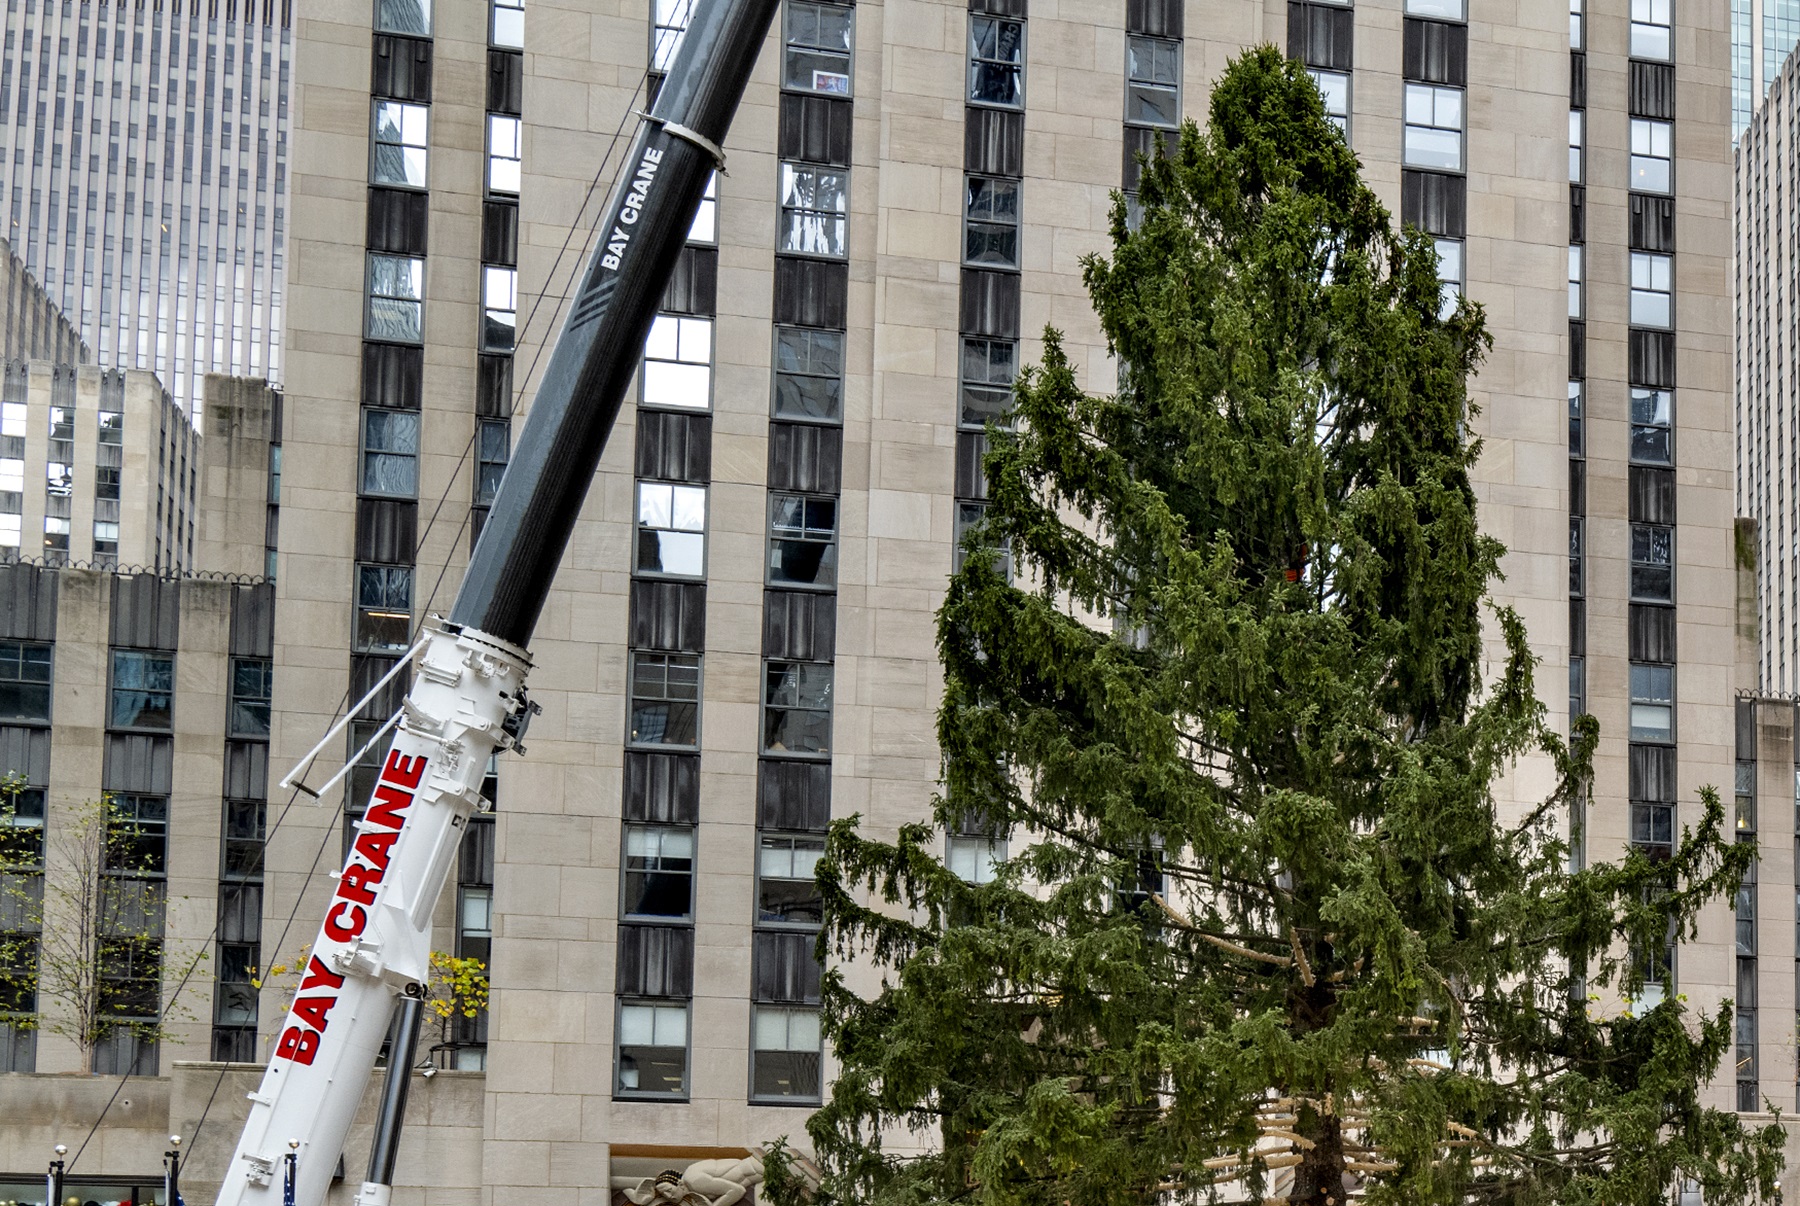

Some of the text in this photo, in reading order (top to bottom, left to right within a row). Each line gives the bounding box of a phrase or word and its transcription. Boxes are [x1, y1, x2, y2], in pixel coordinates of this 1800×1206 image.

[601, 147, 664, 271] BAY CRANE
[276, 748, 429, 1066] BAY CRANE
